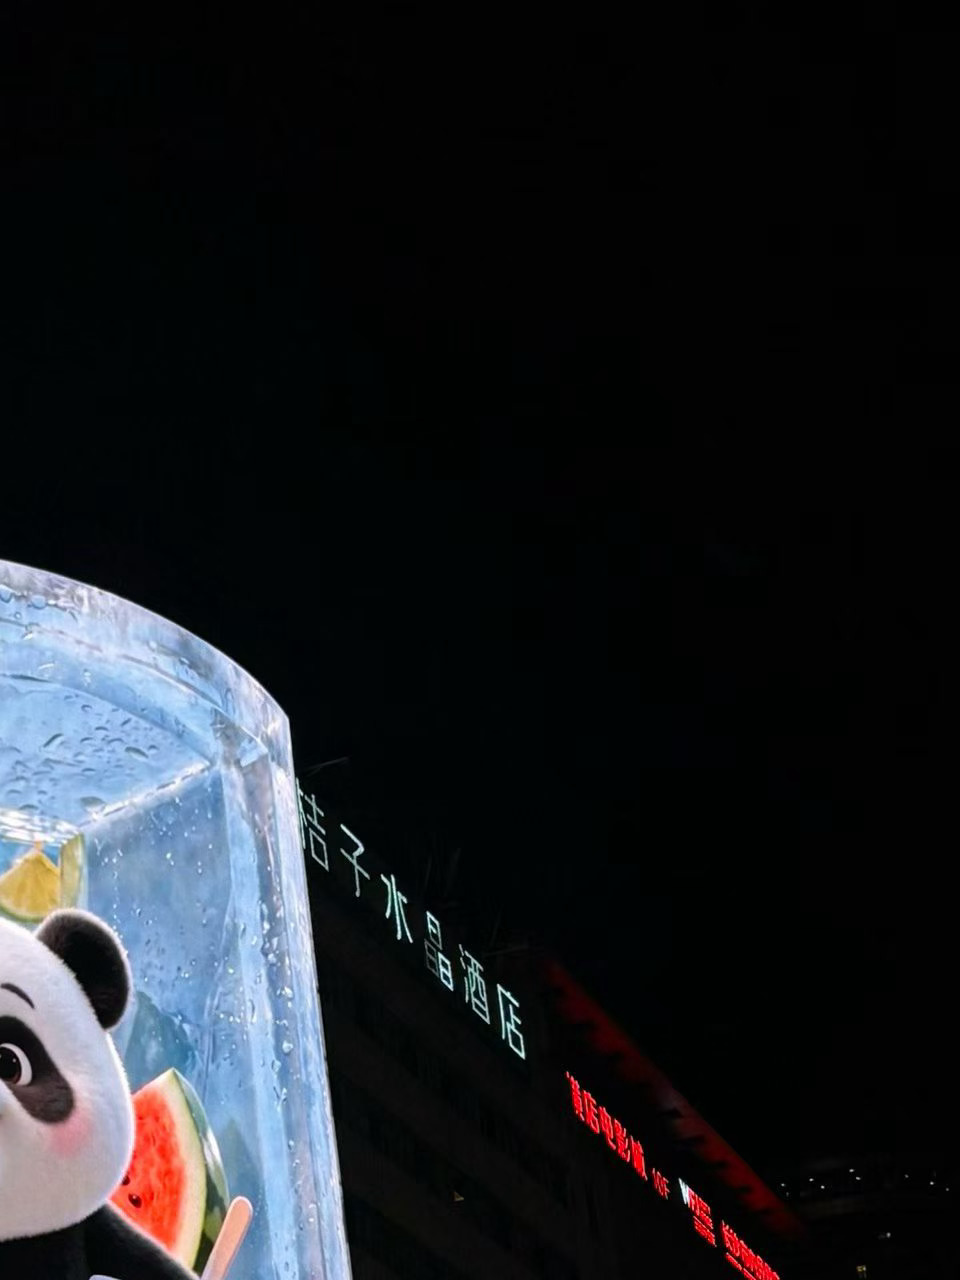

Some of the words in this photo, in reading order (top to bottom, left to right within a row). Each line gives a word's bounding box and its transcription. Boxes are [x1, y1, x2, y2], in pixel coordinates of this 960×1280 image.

[295, 777, 527, 1060] 桔子水晶酒店
